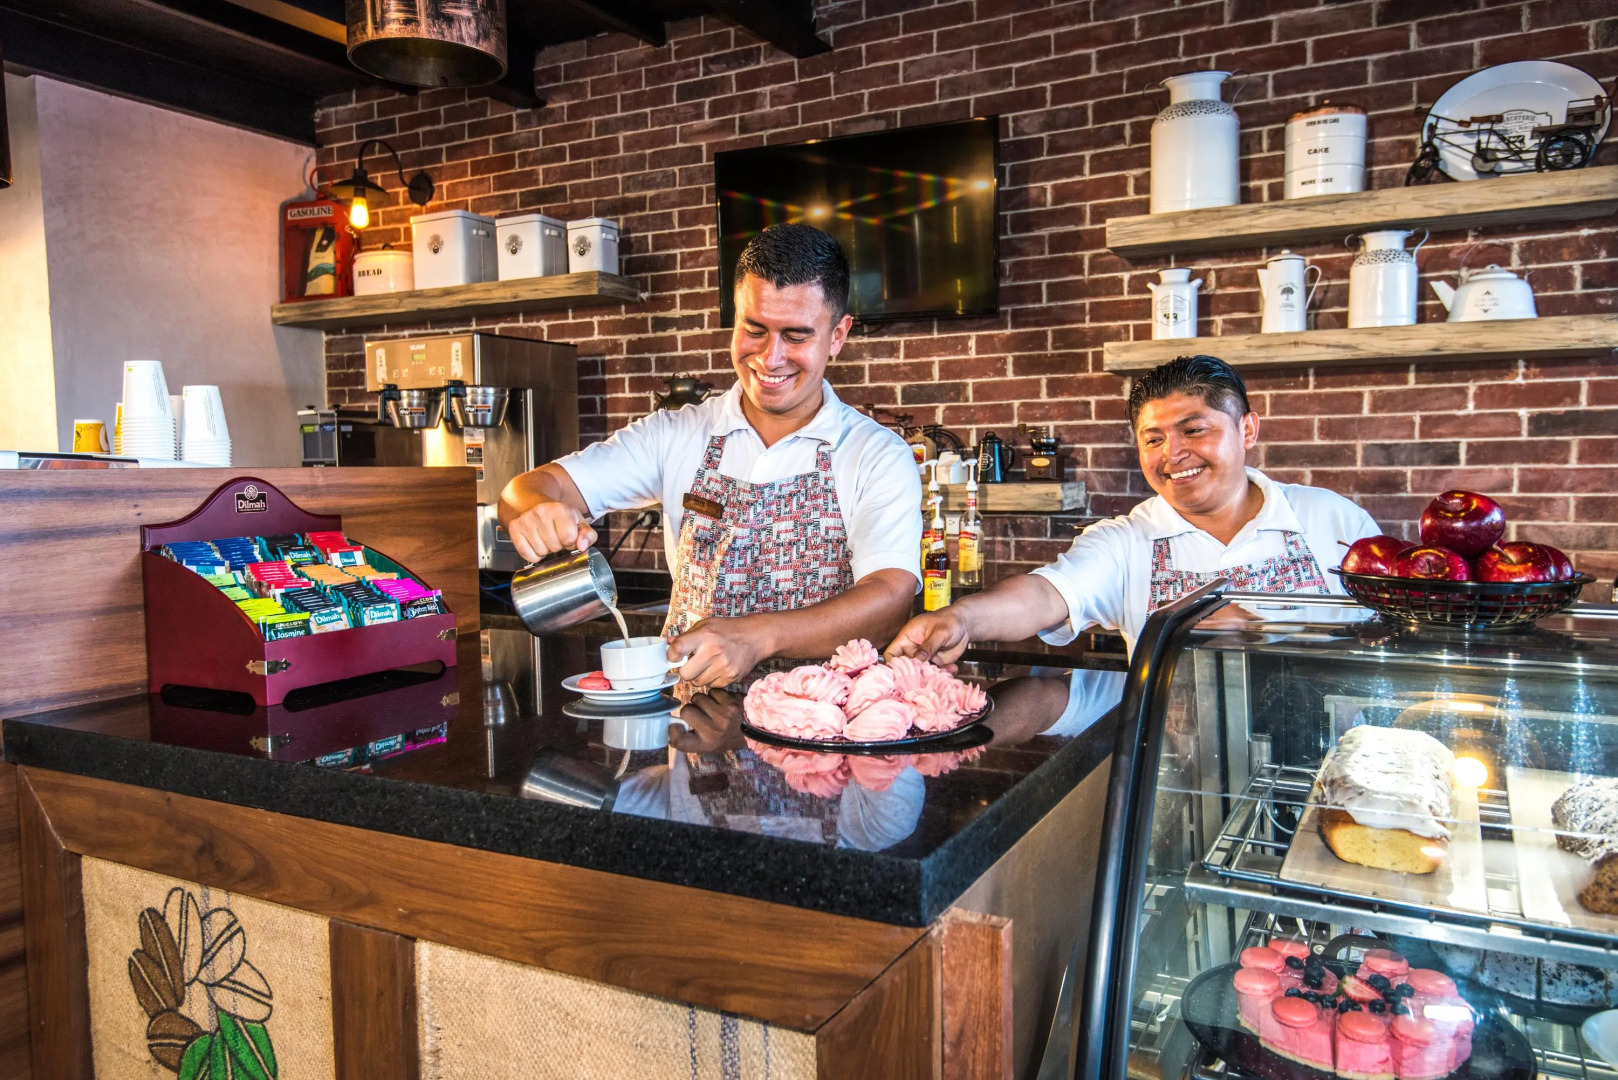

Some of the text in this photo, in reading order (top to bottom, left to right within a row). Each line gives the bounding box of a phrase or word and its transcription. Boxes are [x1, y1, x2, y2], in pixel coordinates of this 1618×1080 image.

[1307, 147, 1330, 155] CAKE
[289, 206, 333, 218] GASOLINE
[358, 268, 382, 277] BREAD
[237, 499, 266, 509] Dilmah
[289, 552, 312, 560] Dilmah
[315, 612, 341, 624] Dilmah
[370, 609, 392, 618] Dilmah
[276, 629, 306, 639] Jasmine
